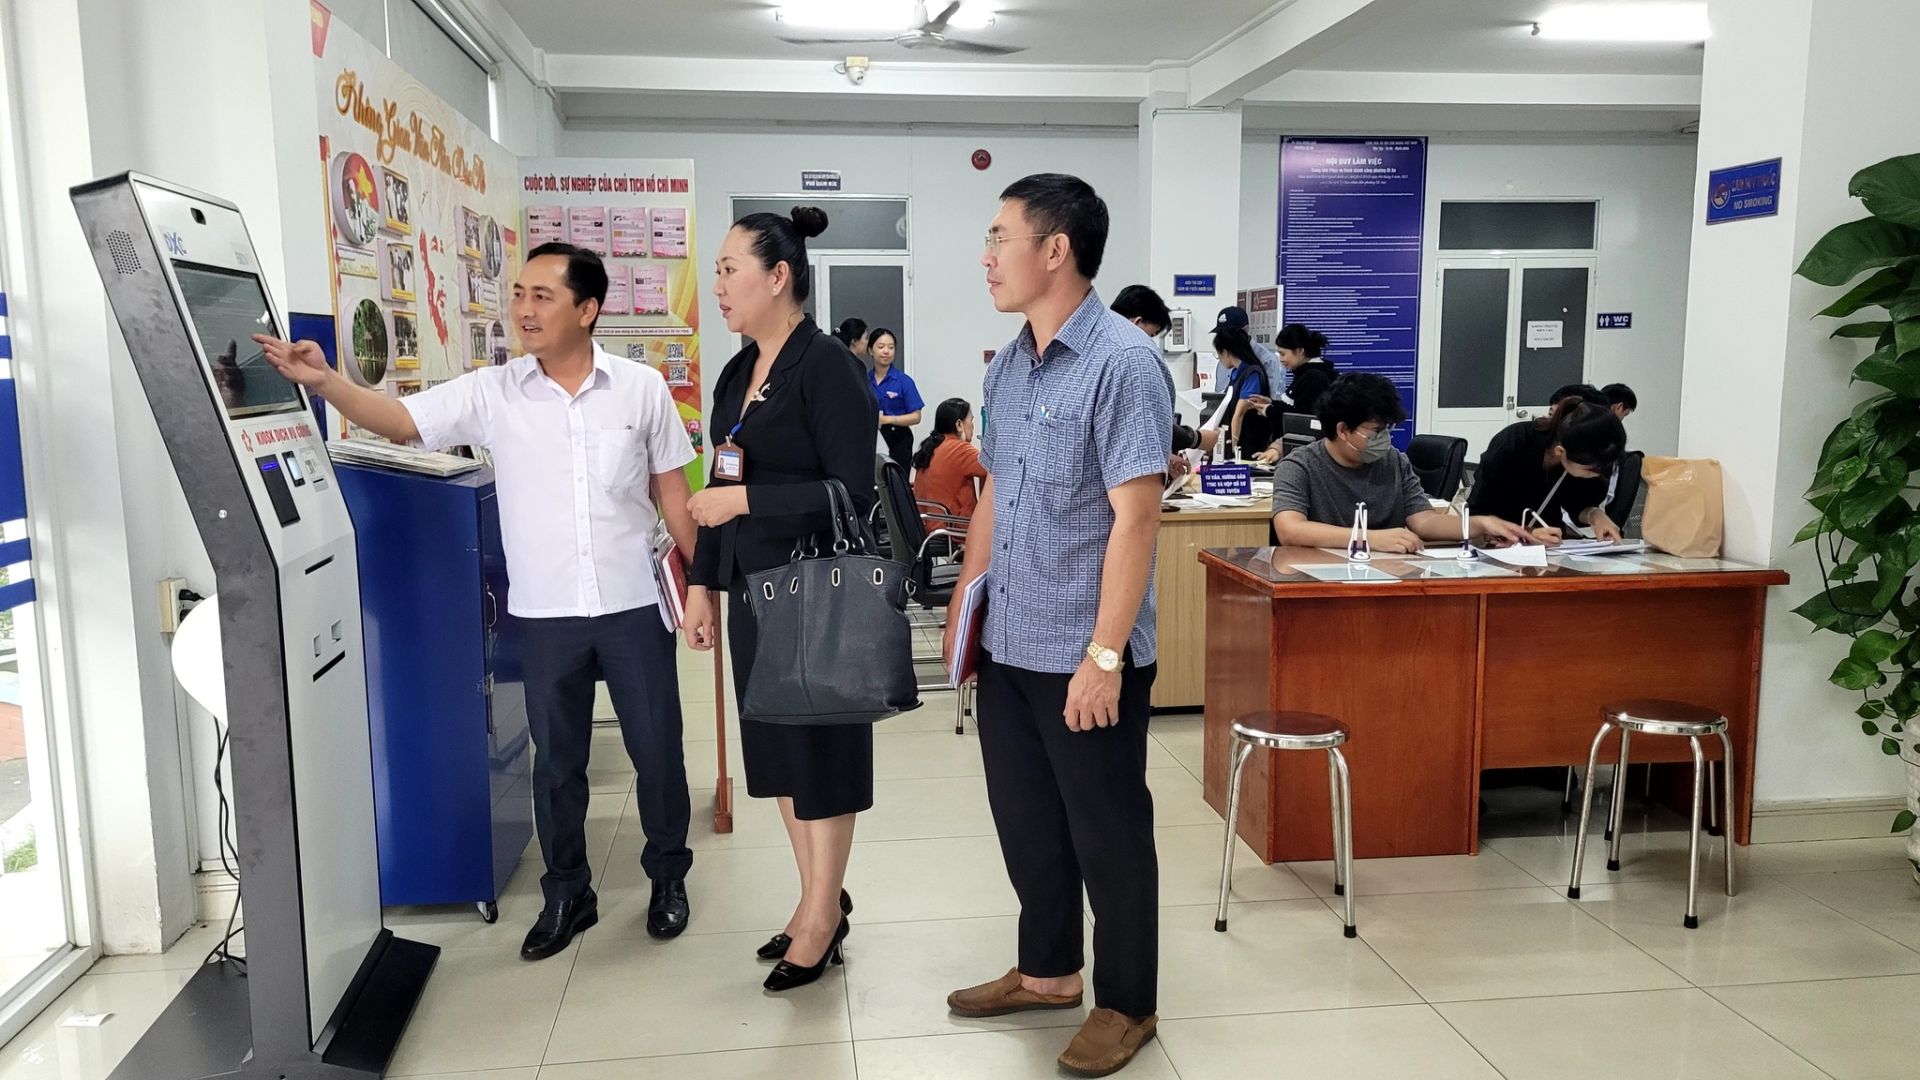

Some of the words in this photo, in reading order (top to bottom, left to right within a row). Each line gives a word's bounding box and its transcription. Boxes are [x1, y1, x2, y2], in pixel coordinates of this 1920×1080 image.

[524, 174, 543, 194] CUỘC
[560, 175, 570, 195] SỰ
[571, 174, 596, 195] NGHIỆP
[598, 173, 613, 192] CỦA
[614, 173, 628, 192] CHỦ
[629, 178, 645, 195] TỊCH
[670, 178, 689, 193] MINH
[1733, 200, 1743, 210] NO
[1743, 195, 1773, 208] SMOKING
